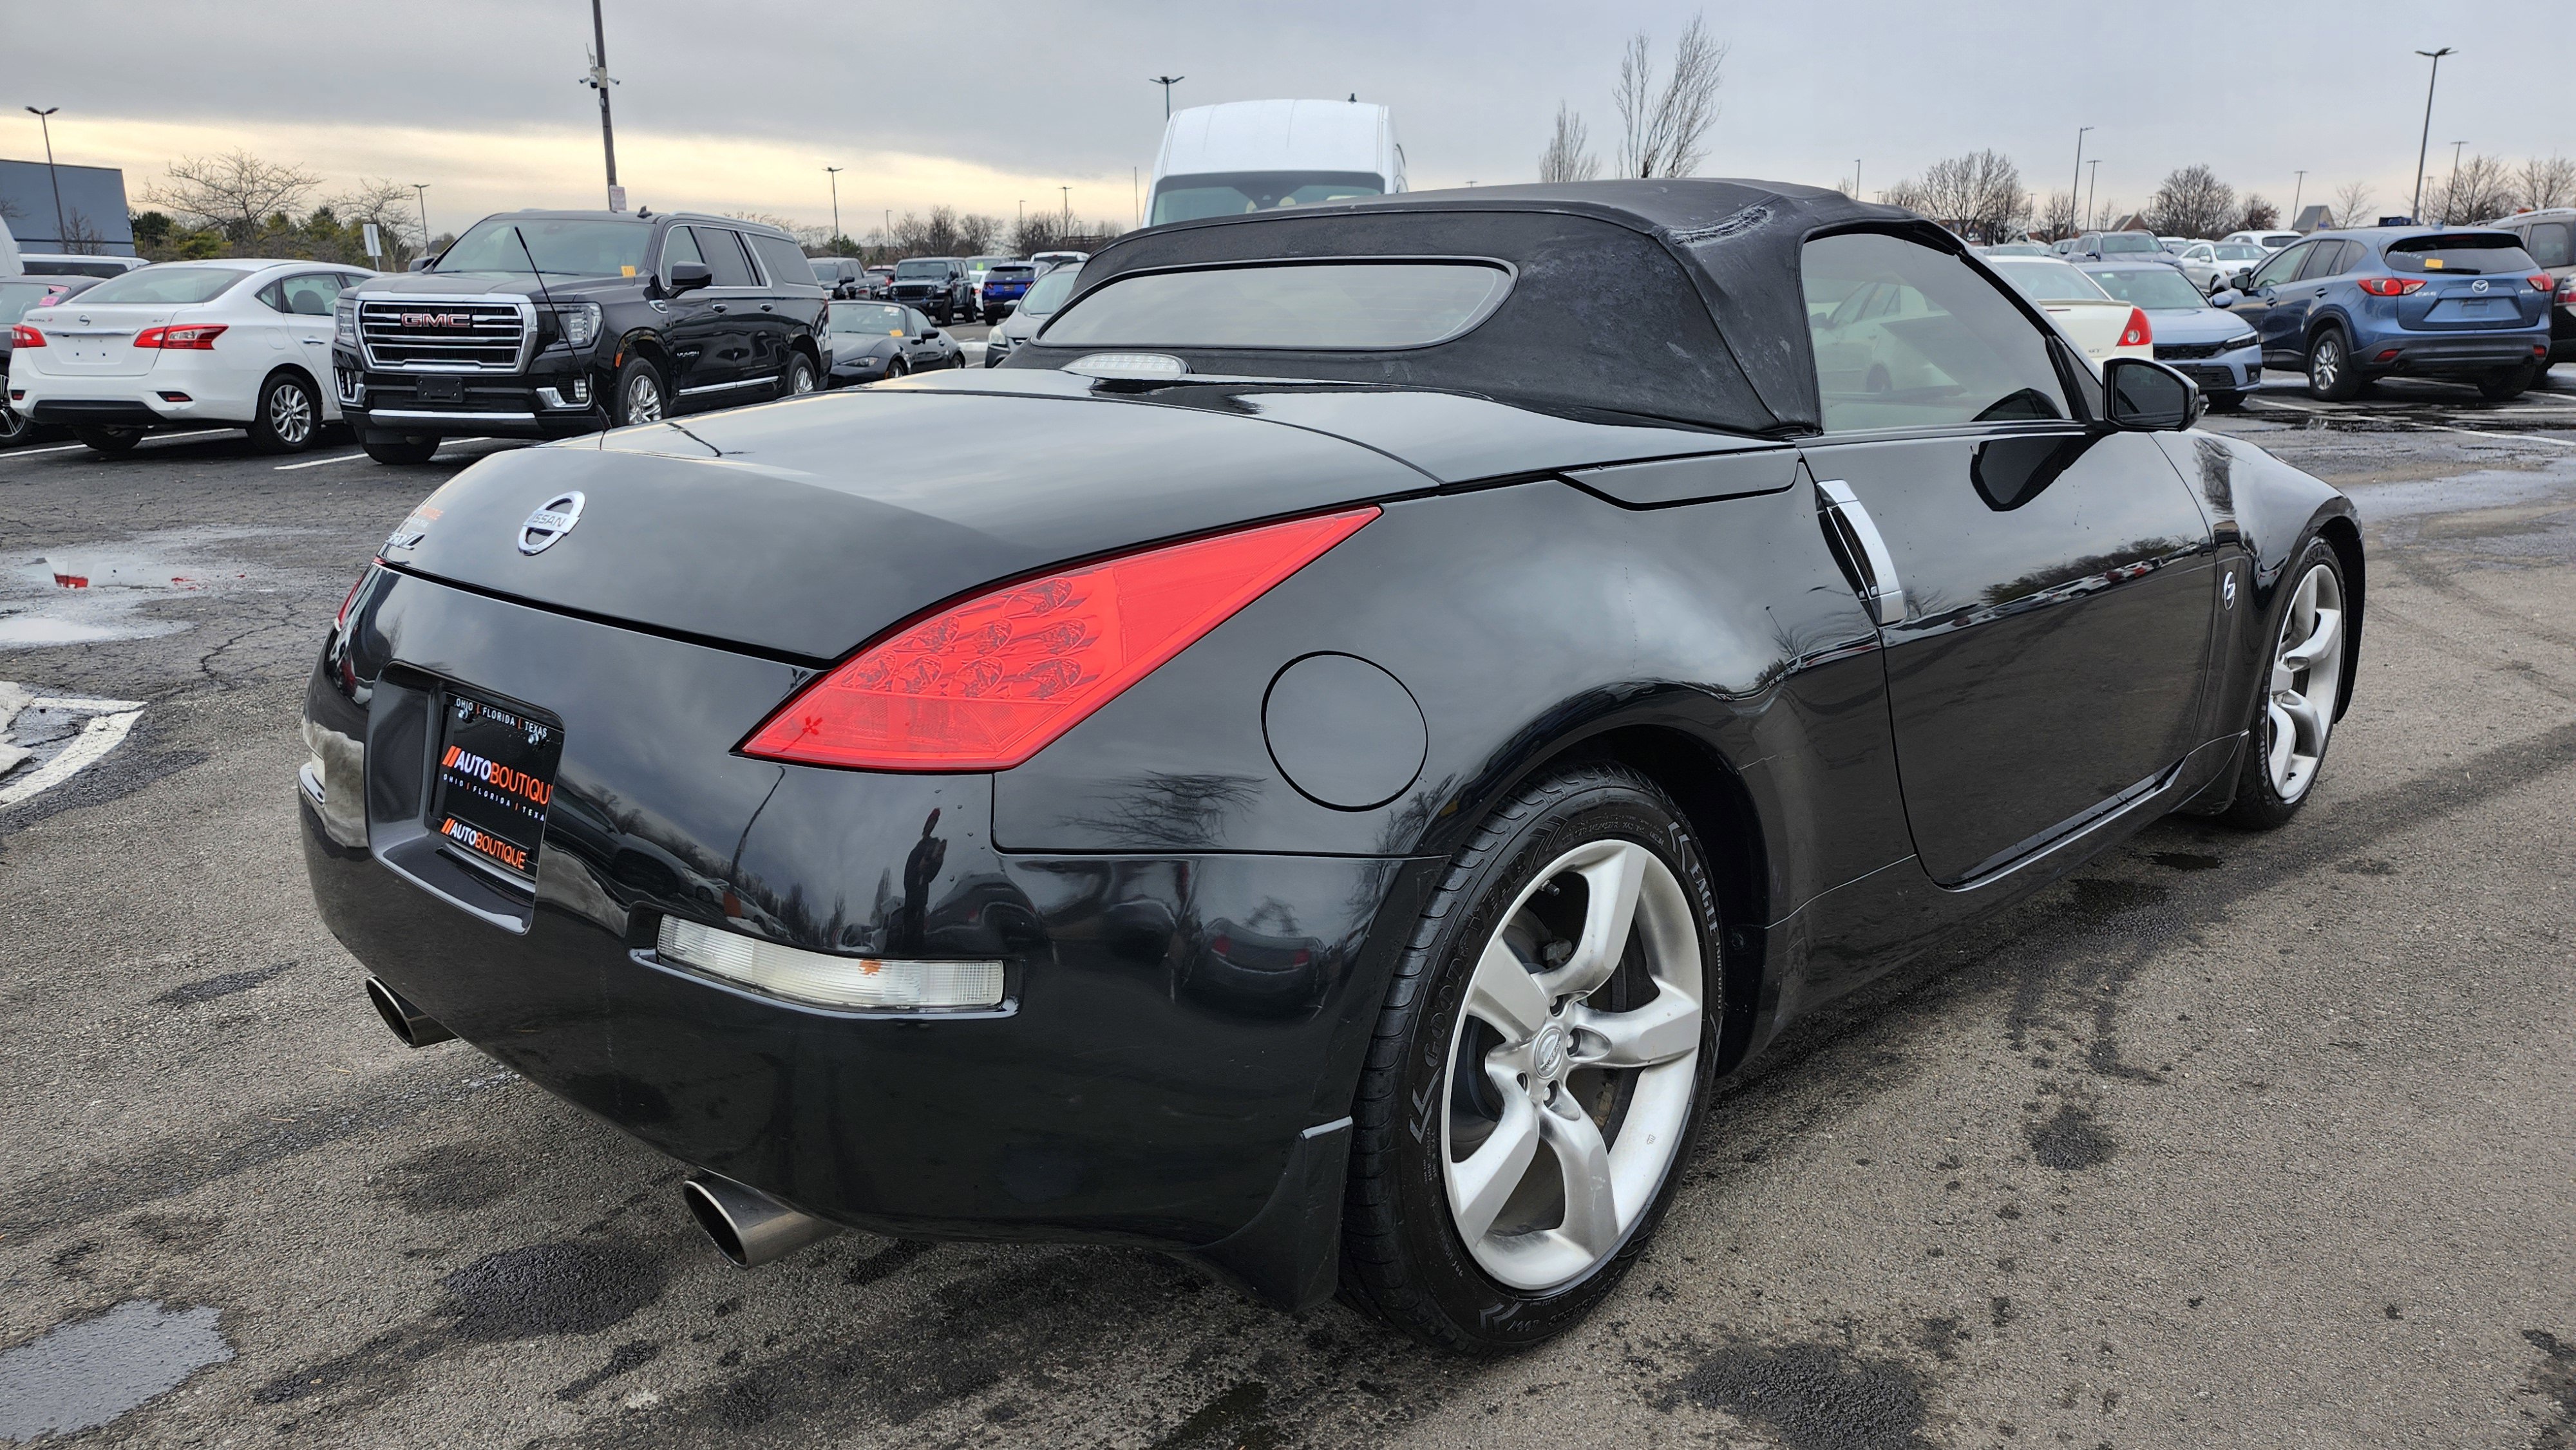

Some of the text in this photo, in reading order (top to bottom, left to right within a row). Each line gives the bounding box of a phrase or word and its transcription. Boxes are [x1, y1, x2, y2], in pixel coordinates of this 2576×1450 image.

[401, 313, 470, 328] GMC
[456, 697, 547, 737] OHIO FLORIDA TEXAS
[443, 773, 545, 822] OHIO FLORIDA TEXA
[453, 749, 553, 805] AUTOBOUTIQU
[450, 822, 528, 870] AUTOBOUTIQUE
[1689, 860, 1719, 936] EAGLE
[1425, 851, 1527, 1067] GOODYEAR
